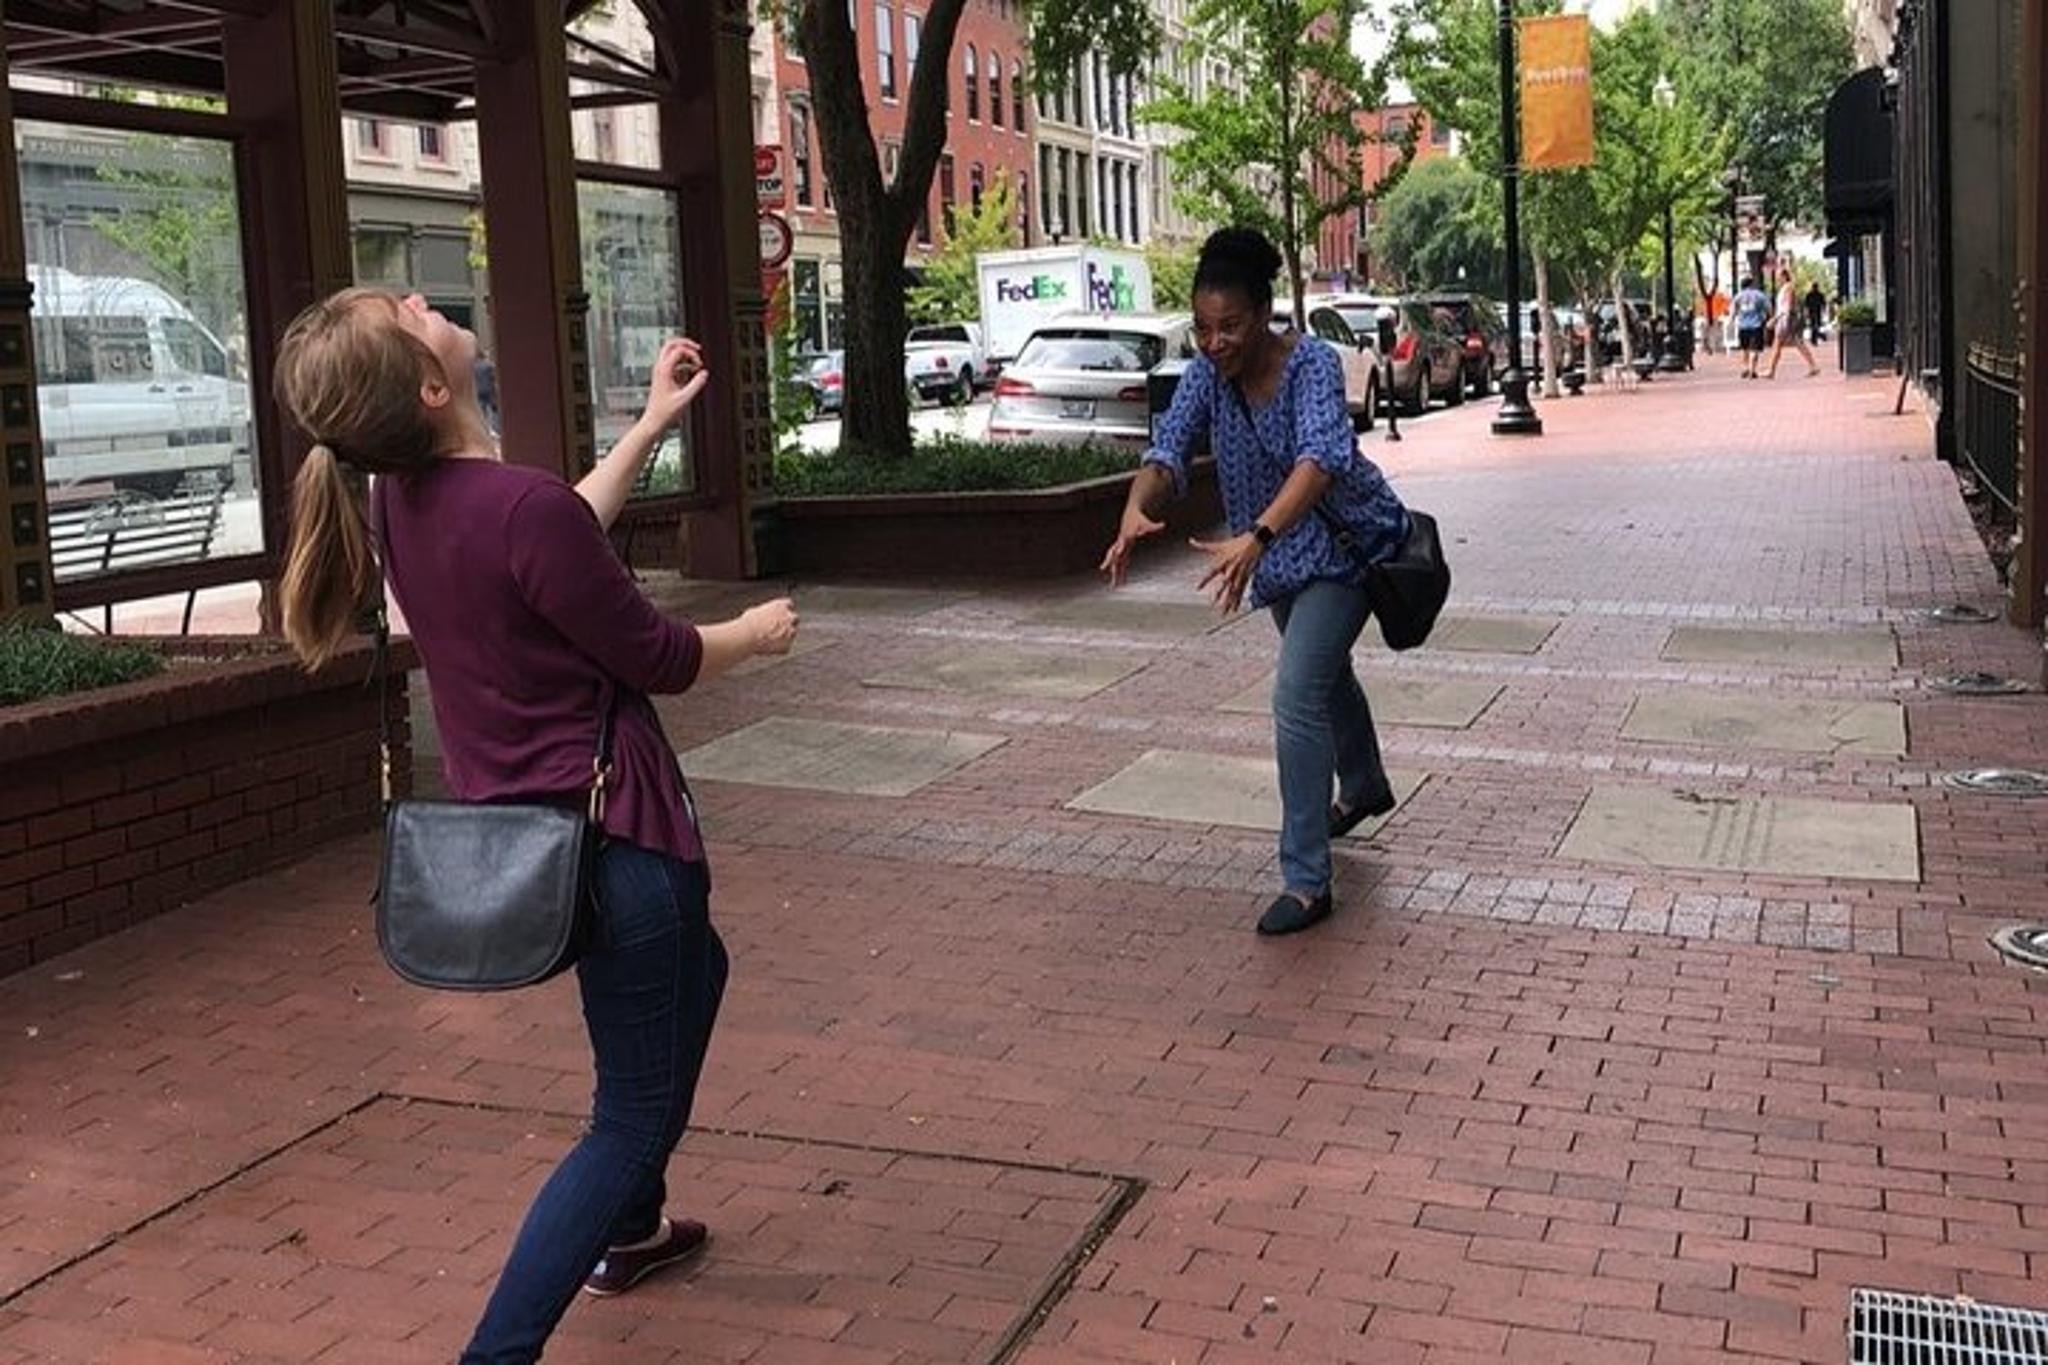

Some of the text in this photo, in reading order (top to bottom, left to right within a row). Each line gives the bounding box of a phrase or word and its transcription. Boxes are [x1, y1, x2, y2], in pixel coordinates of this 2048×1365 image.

[756, 178, 782, 191] TOP
[997, 274, 1067, 302] FedEx
[1087, 261, 1136, 313] FedEx
